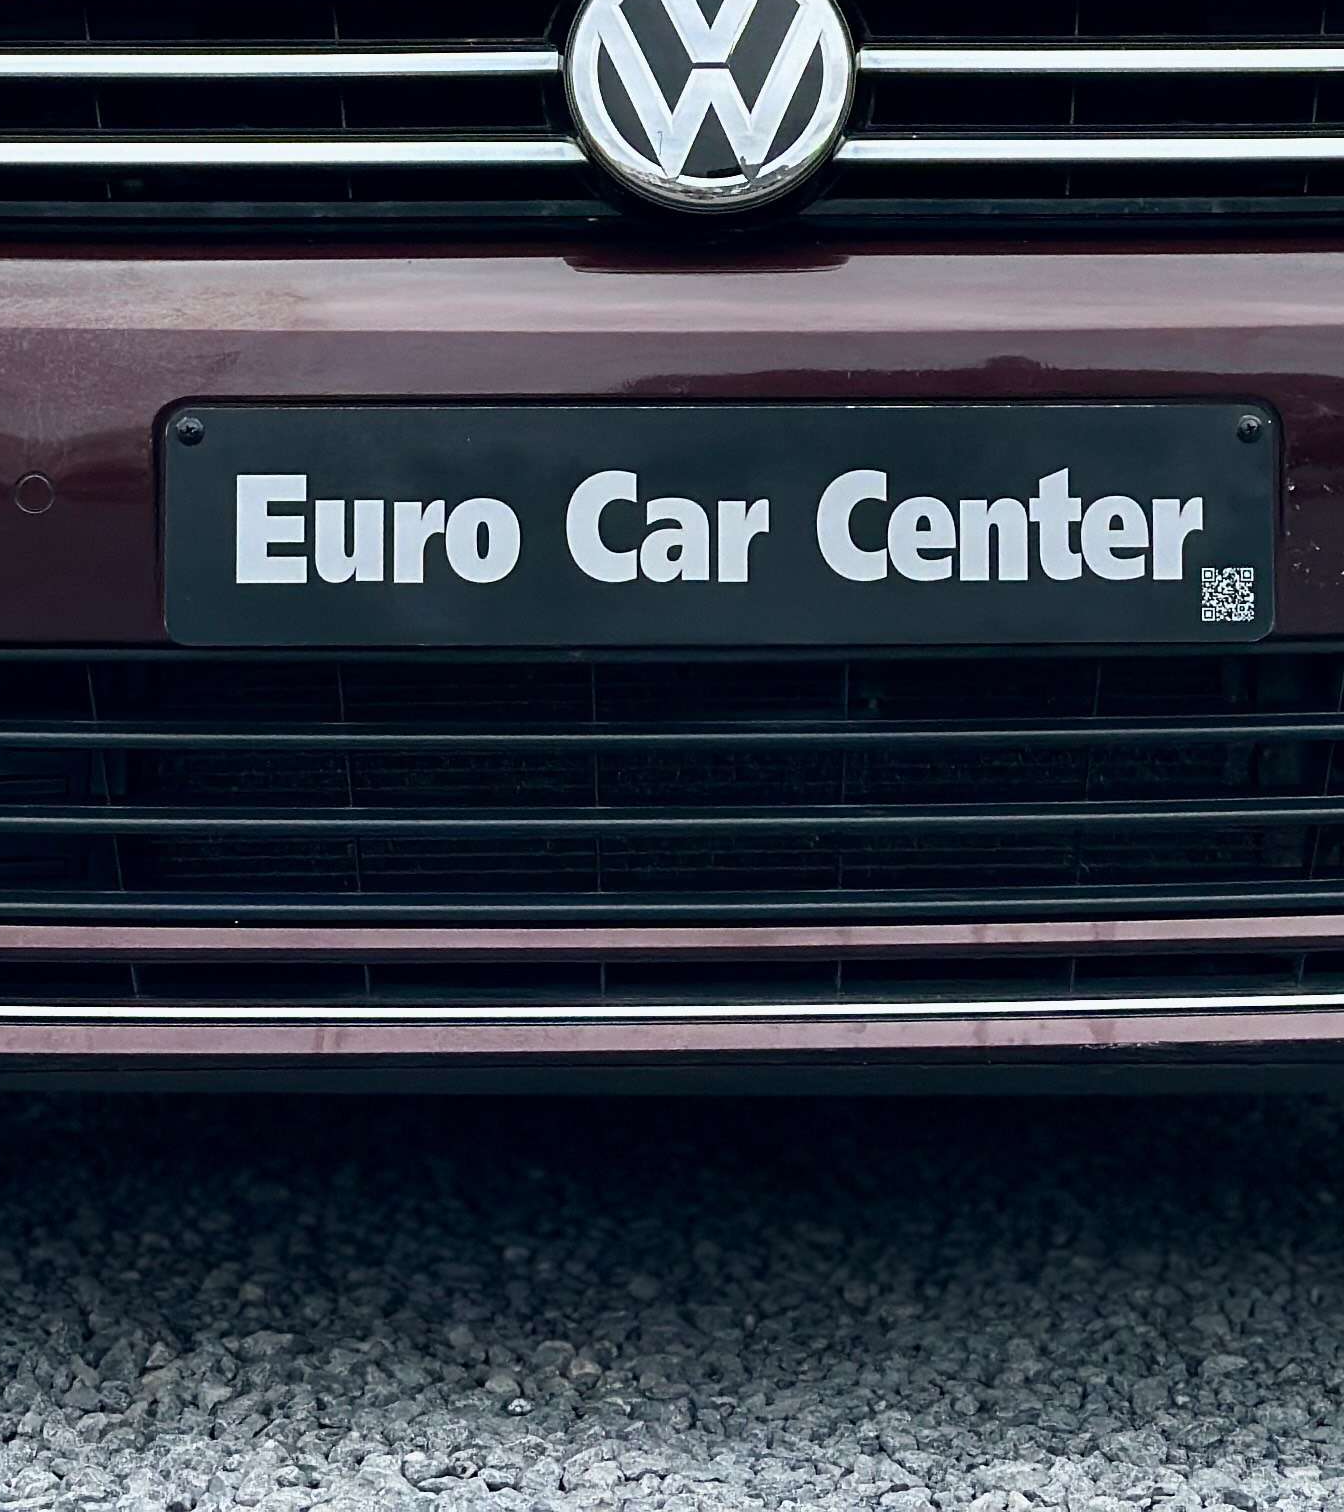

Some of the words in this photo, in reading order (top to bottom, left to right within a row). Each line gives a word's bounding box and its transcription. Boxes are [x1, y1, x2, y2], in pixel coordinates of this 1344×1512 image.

[235, 473, 522, 585] Euro
[565, 469, 771, 584] Car
[816, 467, 1205, 583] Center
